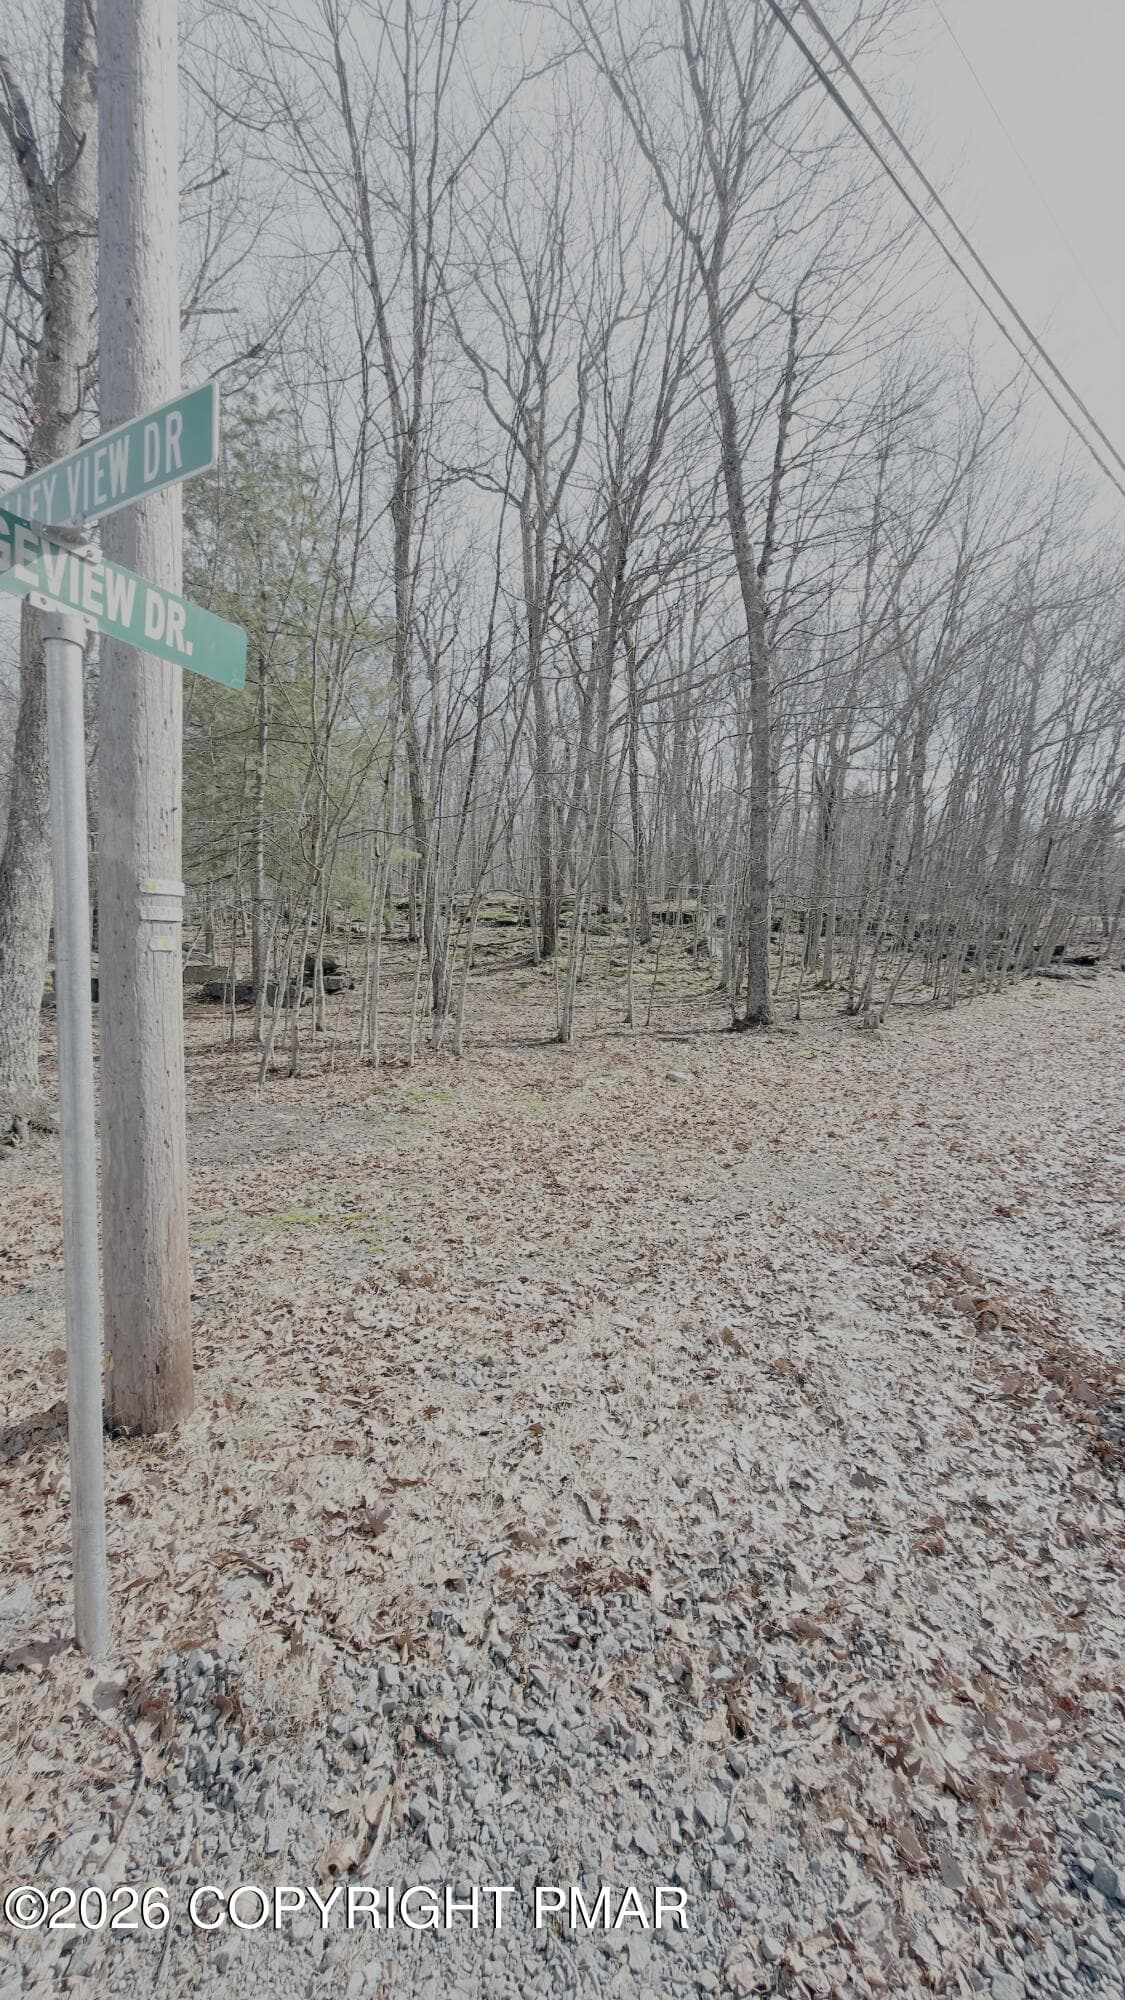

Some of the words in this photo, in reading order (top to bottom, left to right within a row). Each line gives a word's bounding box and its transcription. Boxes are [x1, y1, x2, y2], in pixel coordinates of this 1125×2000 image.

[67, 434, 131, 518] VIEW
[143, 410, 184, 483] DR
[144, 588, 193, 656] DR.
